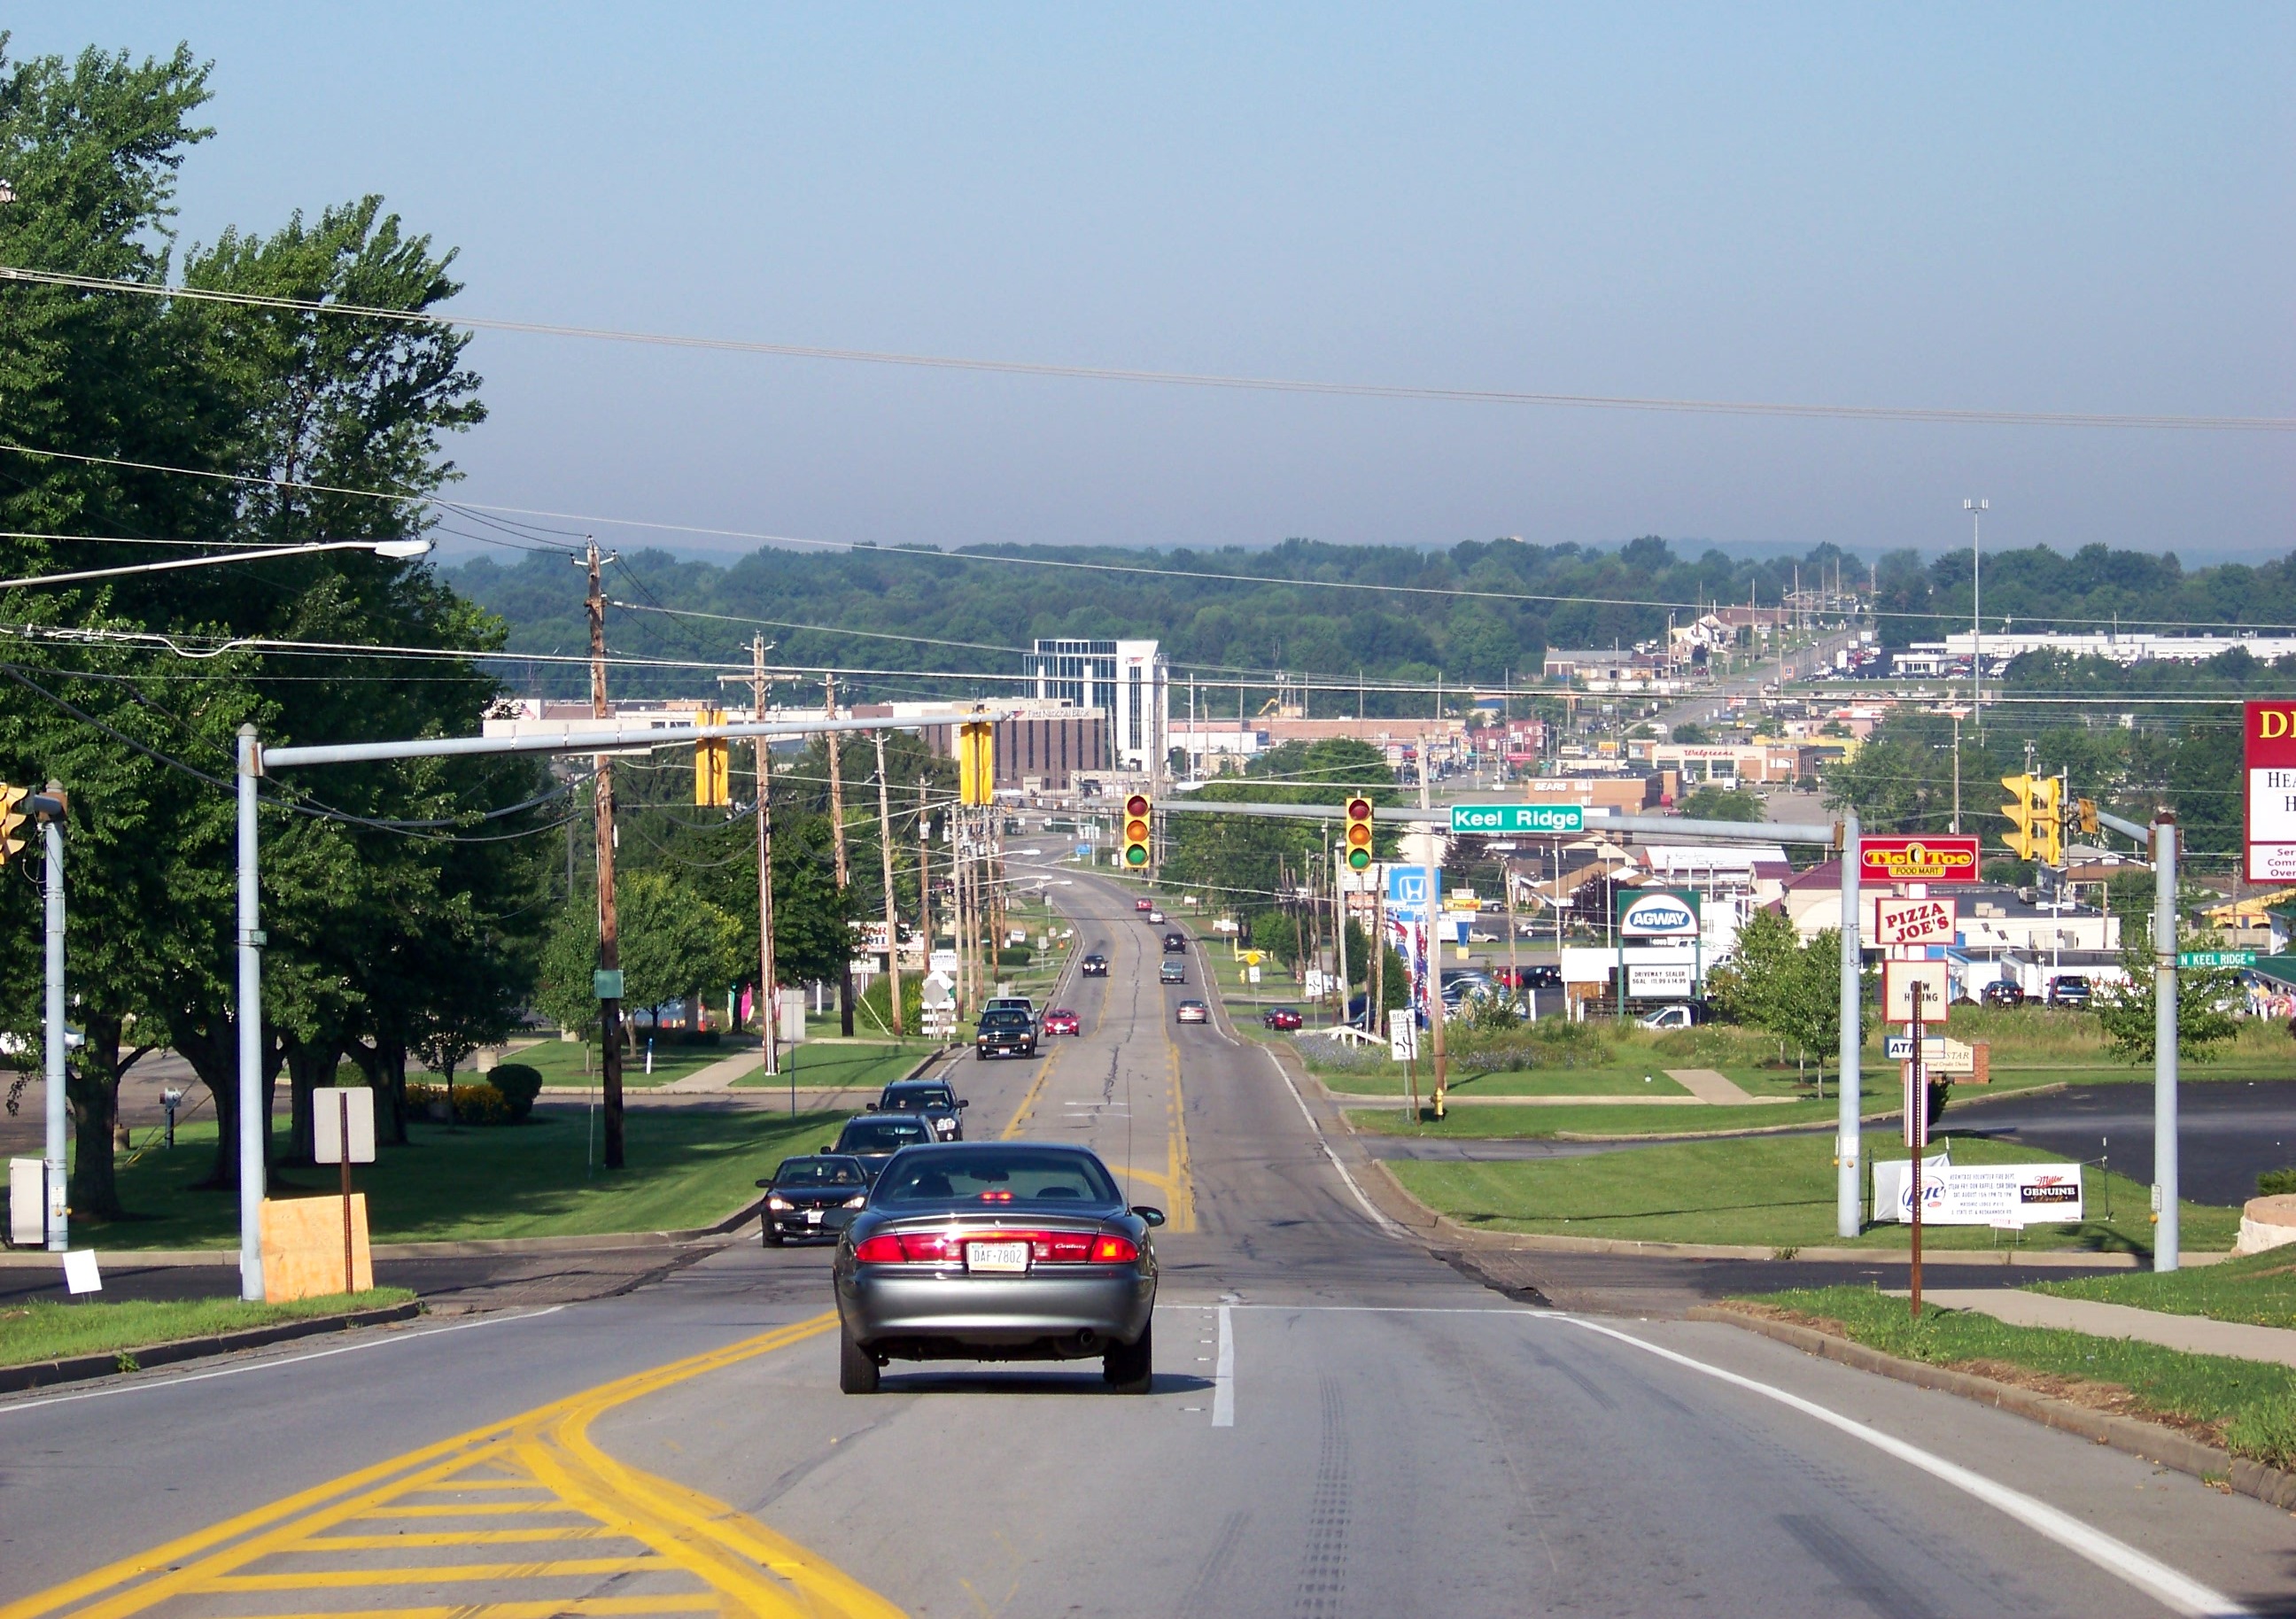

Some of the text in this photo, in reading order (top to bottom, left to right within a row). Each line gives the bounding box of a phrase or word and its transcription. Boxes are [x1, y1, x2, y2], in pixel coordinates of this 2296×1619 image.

[2259, 711, 2296, 738] D
[1684, 749, 1734, 758] Walgreens
[1534, 782, 1567, 792] SEARS
[1454, 810, 1579, 830] Keel Ridge
[1867, 851, 1972, 864] Tic Toc
[1896, 866, 1940, 875] FOOD MART
[1633, 912, 1686, 926] AGWAY
[1885, 902, 1945, 928] PIZZA
[1896, 916, 1950, 942] JOE'S
[2181, 954, 2188, 965] N
[2192, 954, 2217, 965] KEEL
[2220, 954, 2246, 964] RIDGE
[2035, 1175, 2064, 1186] Miller
[2023, 1187, 2075, 1196] GENUINE
